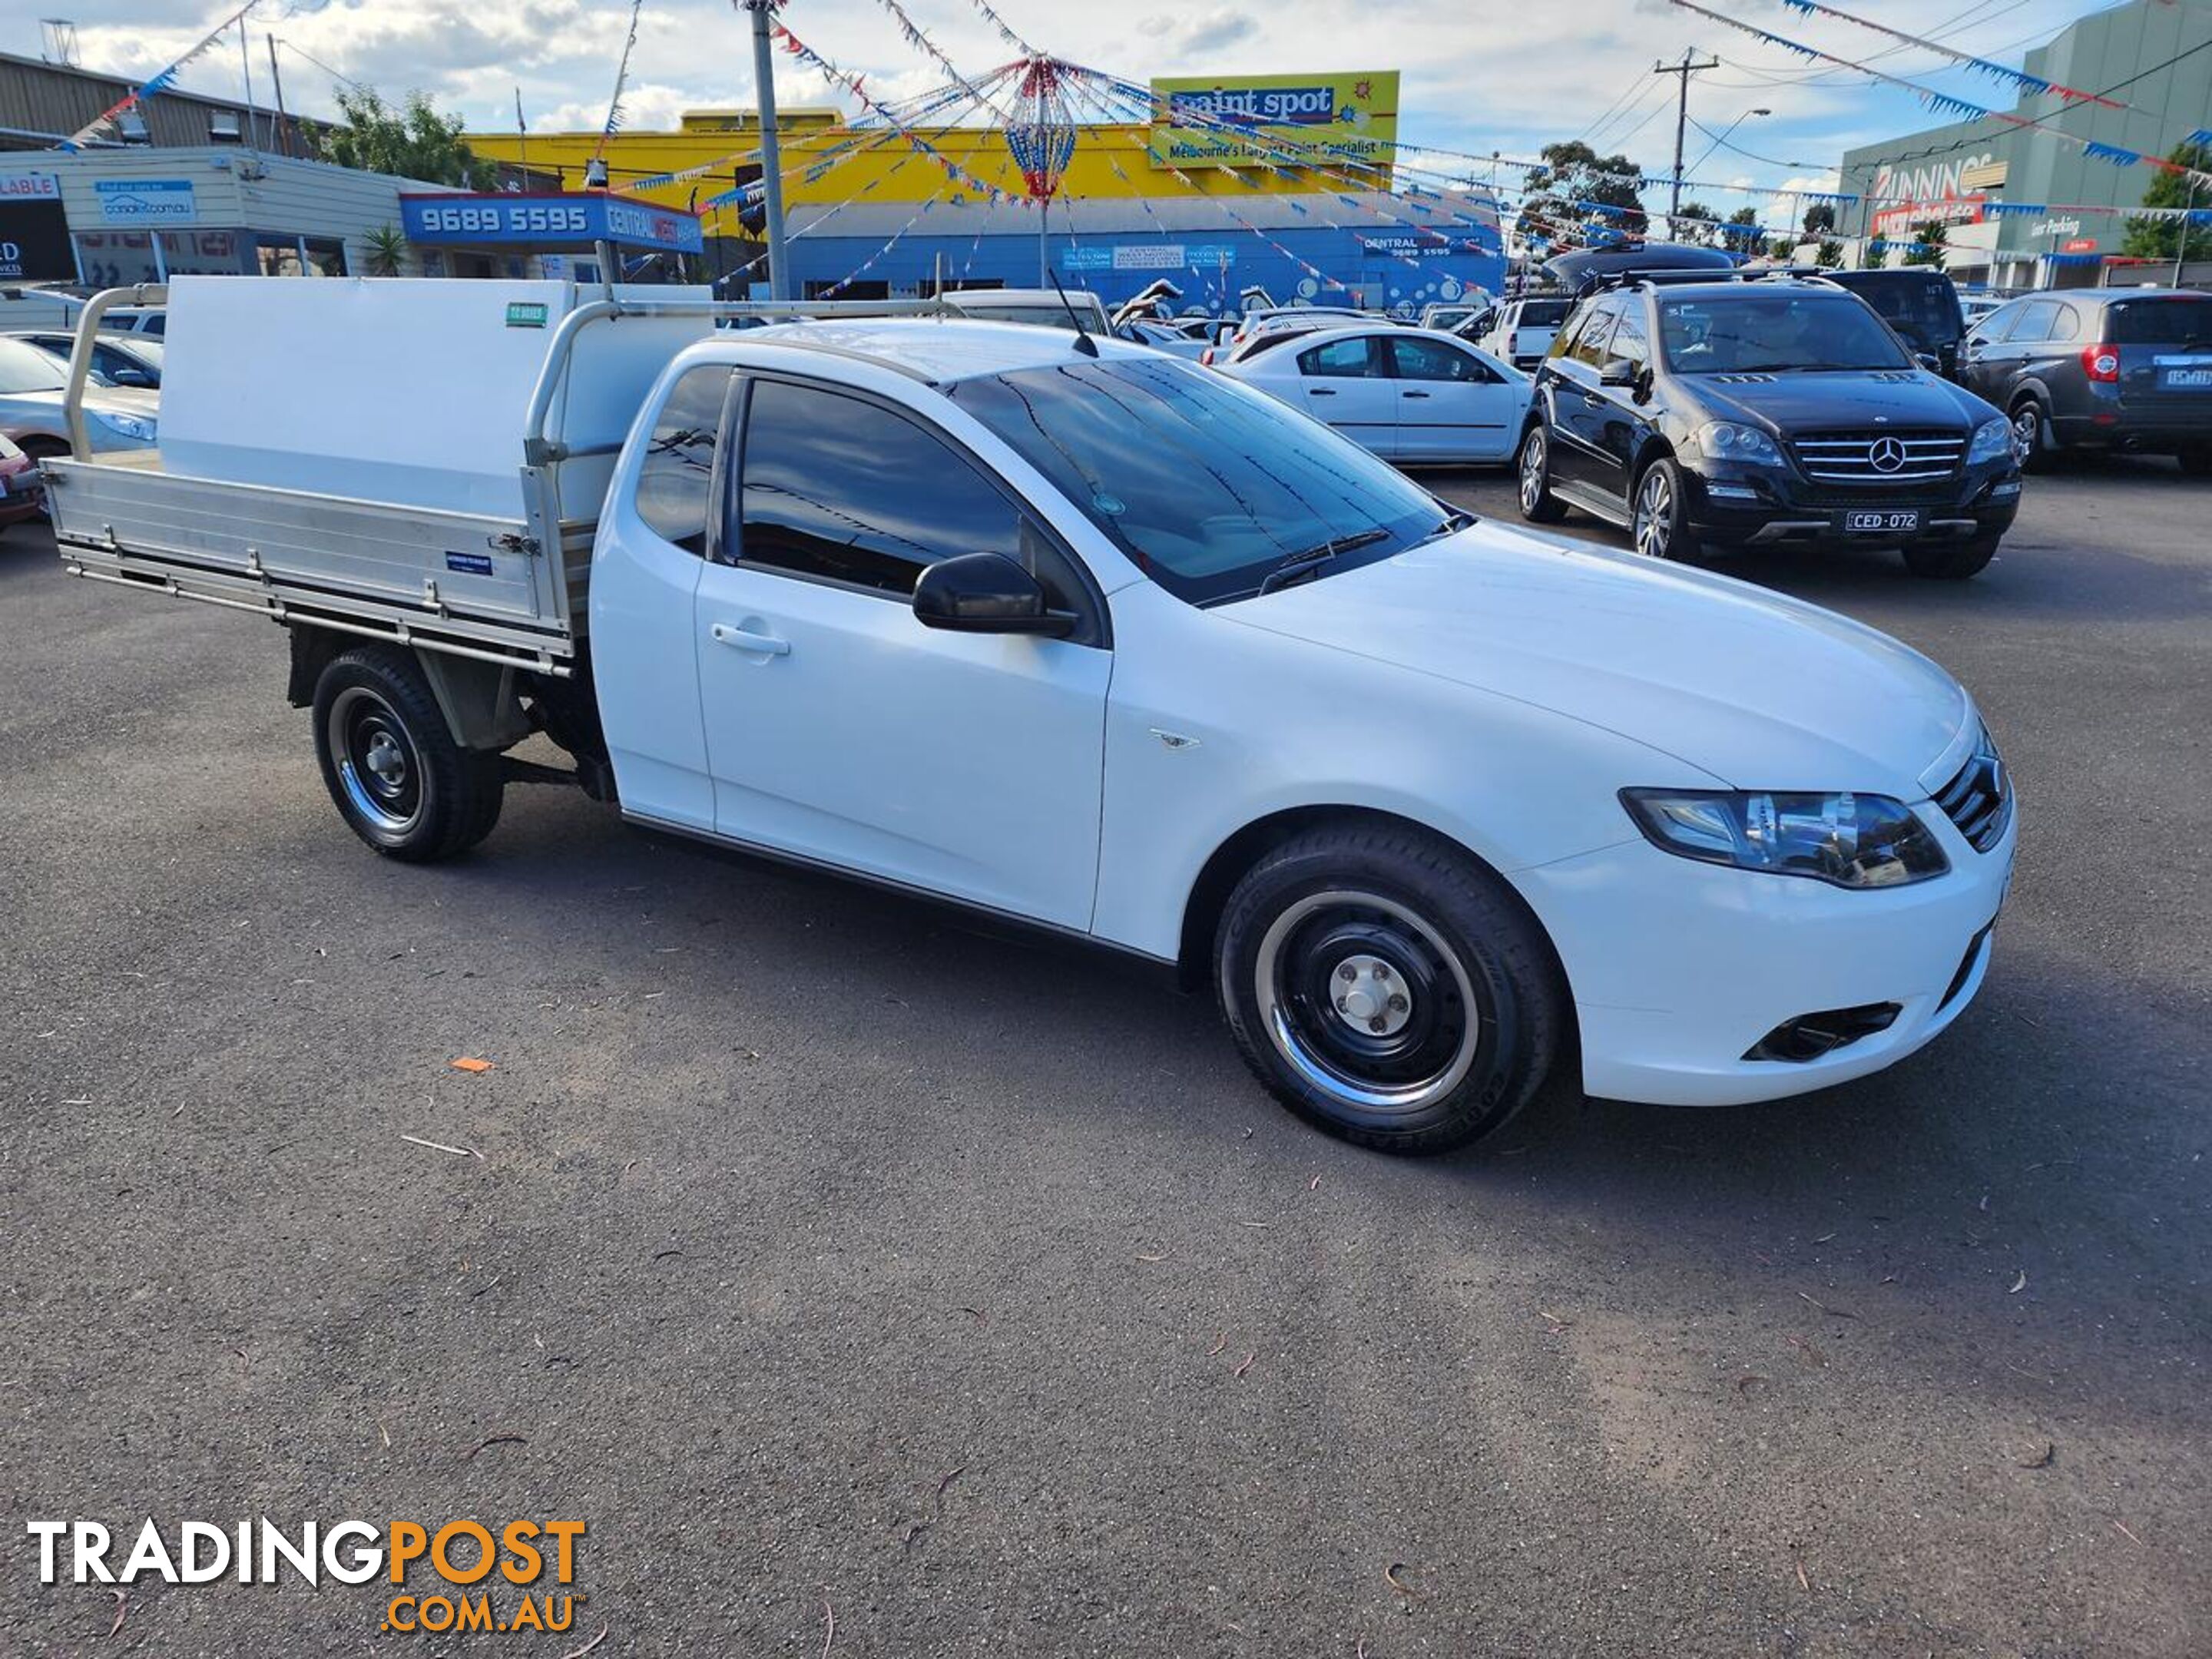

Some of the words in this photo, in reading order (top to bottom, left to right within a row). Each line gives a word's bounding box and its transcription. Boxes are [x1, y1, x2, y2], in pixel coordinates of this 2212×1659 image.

[1264, 88, 1331, 121] spot
[421, 209, 501, 231] 9689
[510, 207, 586, 230] 5595
[608, 204, 657, 240] CENTRAL
[2047, 215, 2079, 236] Parking
